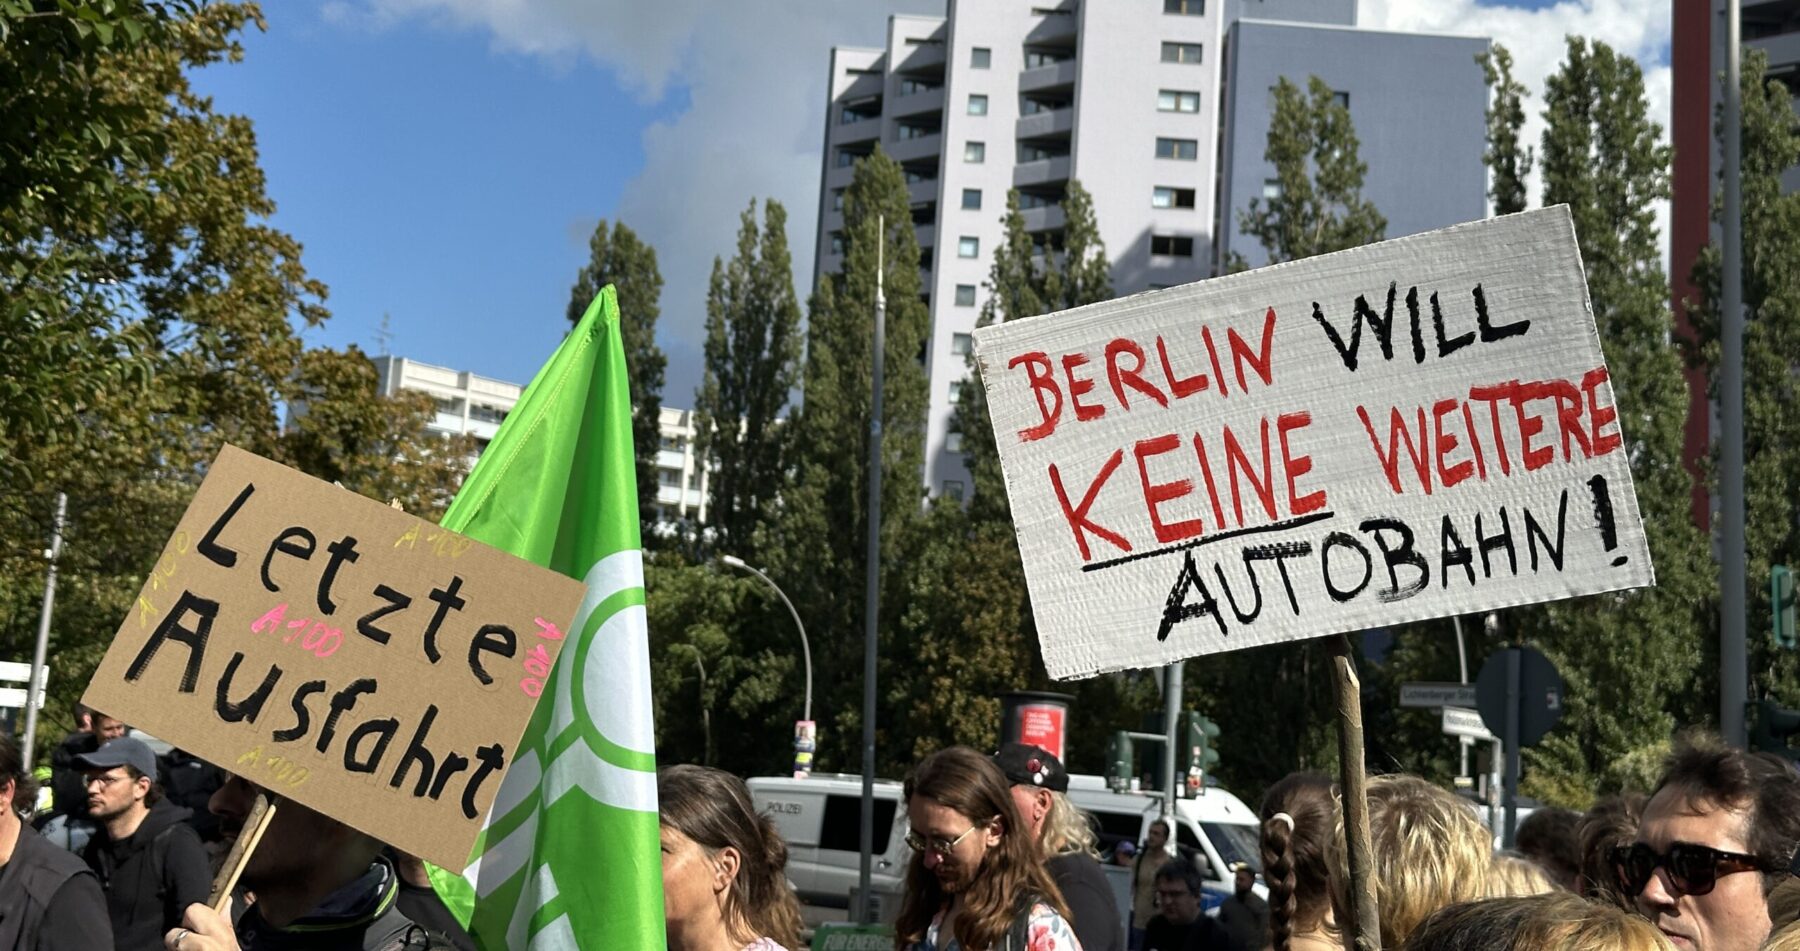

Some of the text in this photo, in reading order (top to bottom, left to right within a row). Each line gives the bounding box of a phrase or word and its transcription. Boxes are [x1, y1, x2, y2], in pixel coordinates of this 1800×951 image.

[1008, 280, 1531, 442] BERLIN WILL
[1048, 366, 1622, 561] KEINE WEITERE
[197, 482, 517, 686] Letzte
[1157, 474, 1629, 642] AUTOBAHN!
[124, 589, 505, 820] Ausfahrt
[768, 802, 802, 815] POLIZEI
